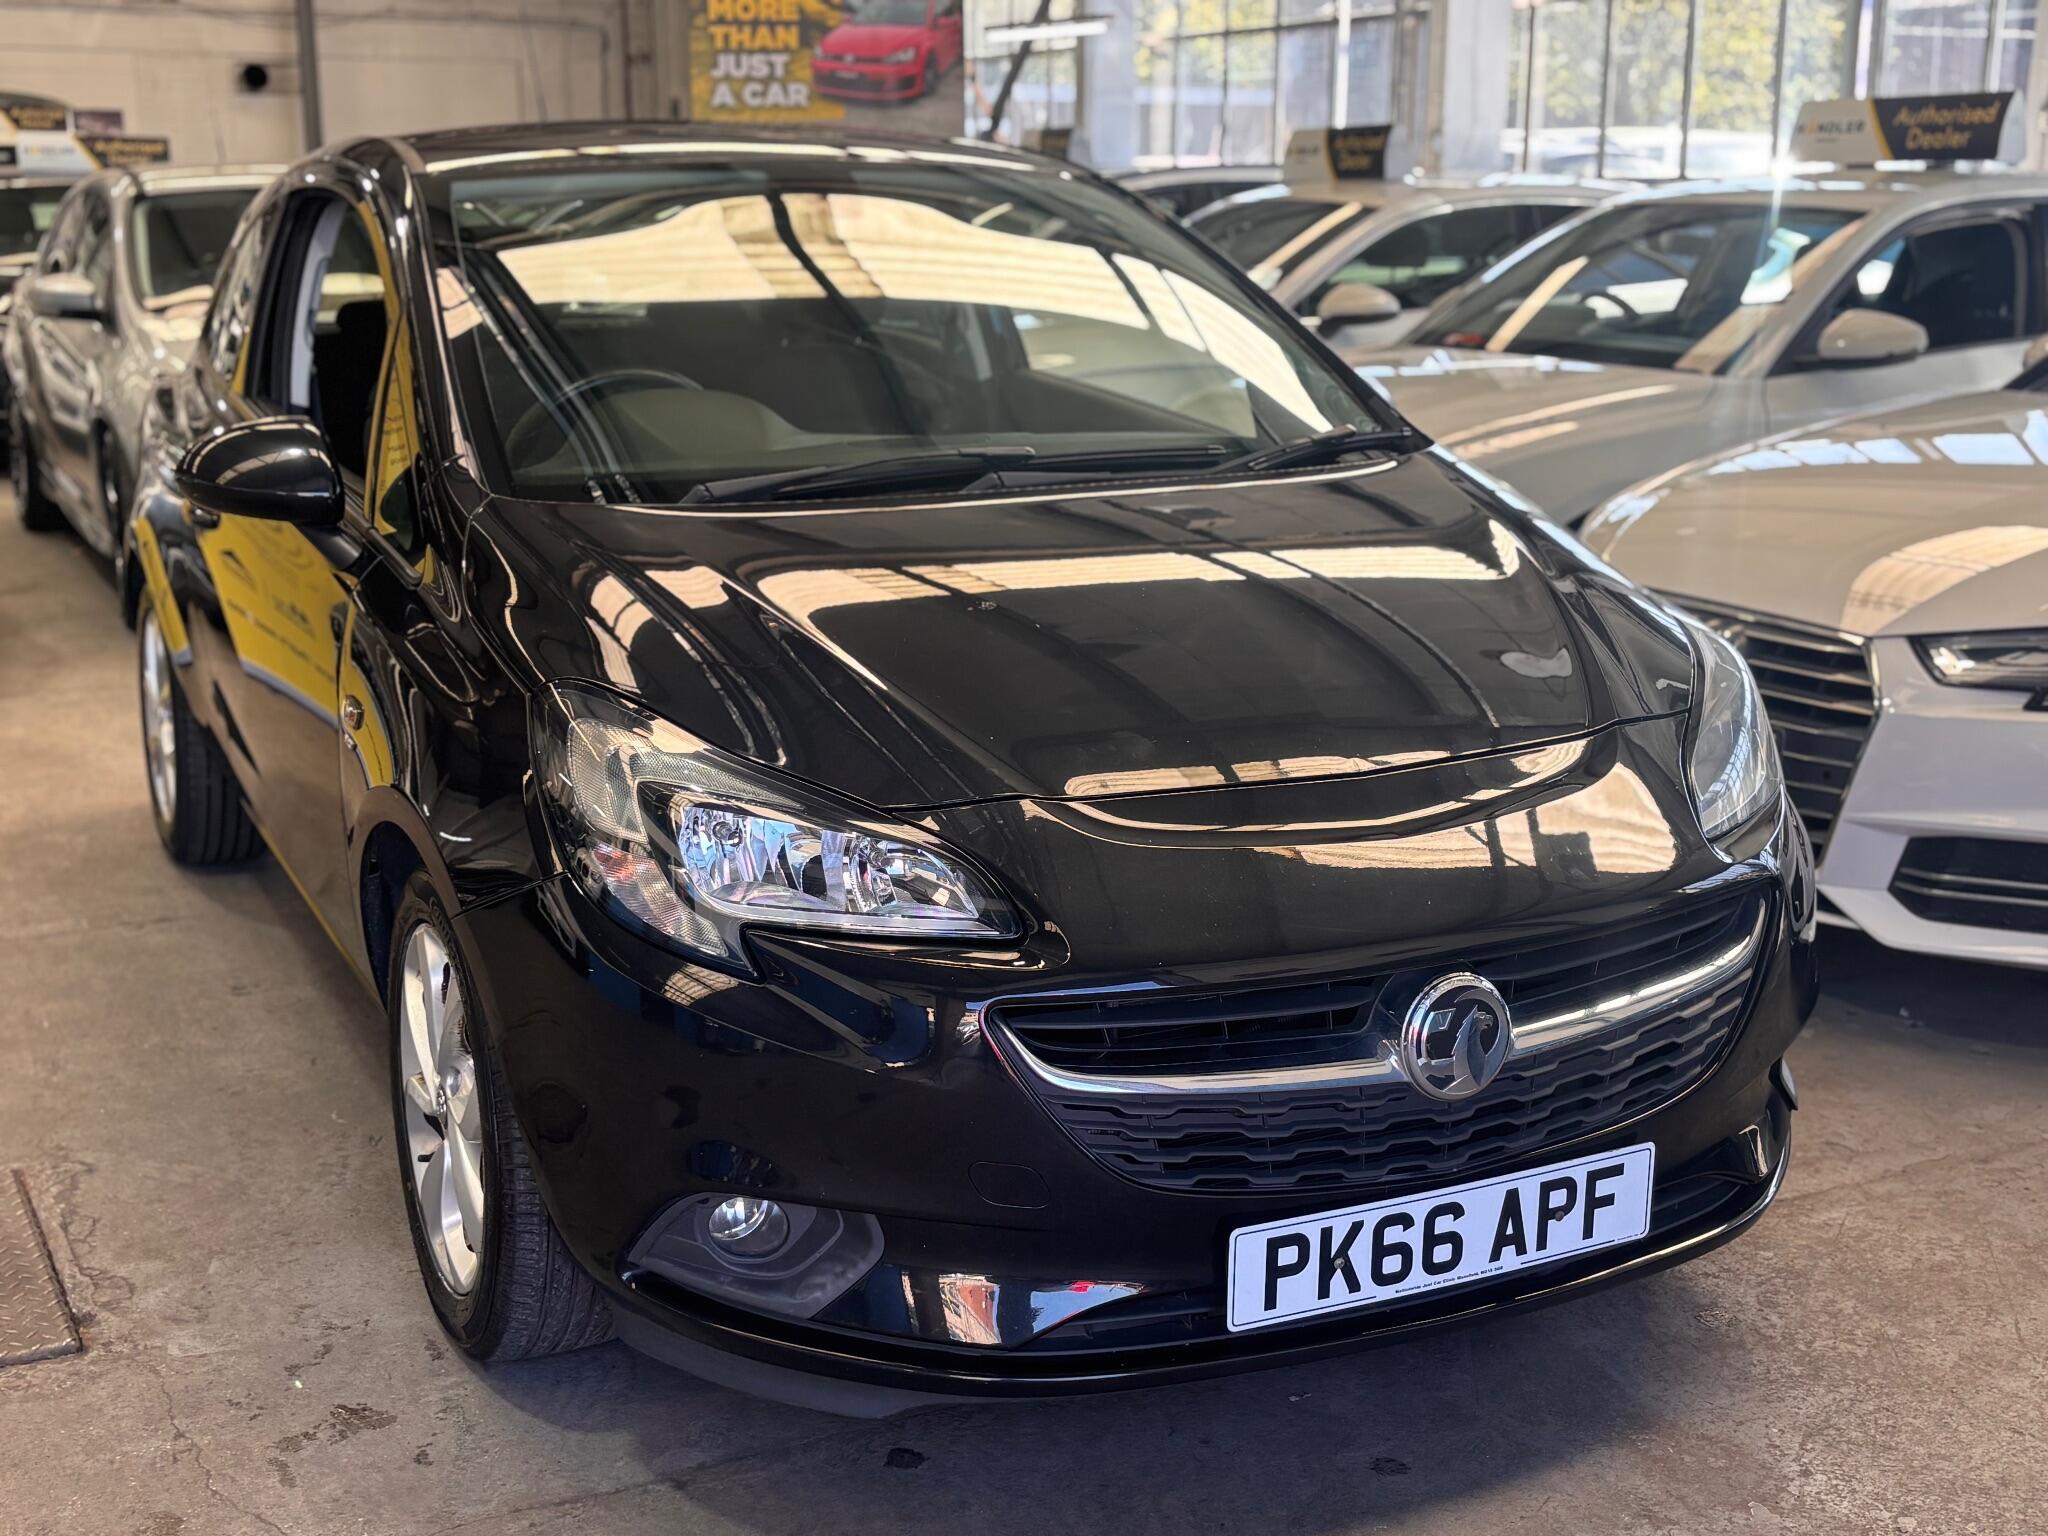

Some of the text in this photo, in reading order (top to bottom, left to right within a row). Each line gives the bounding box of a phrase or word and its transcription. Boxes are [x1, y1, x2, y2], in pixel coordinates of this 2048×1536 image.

[707, 0, 799, 21] MORE
[707, 24, 799, 49] THAN
[710, 53, 790, 79] JUST
[711, 82, 810, 108] A CAR
[1892, 99, 2001, 128] Authorised
[1905, 125, 1973, 150] Dealer
[1263, 1162, 1625, 1312] PK66 APF
